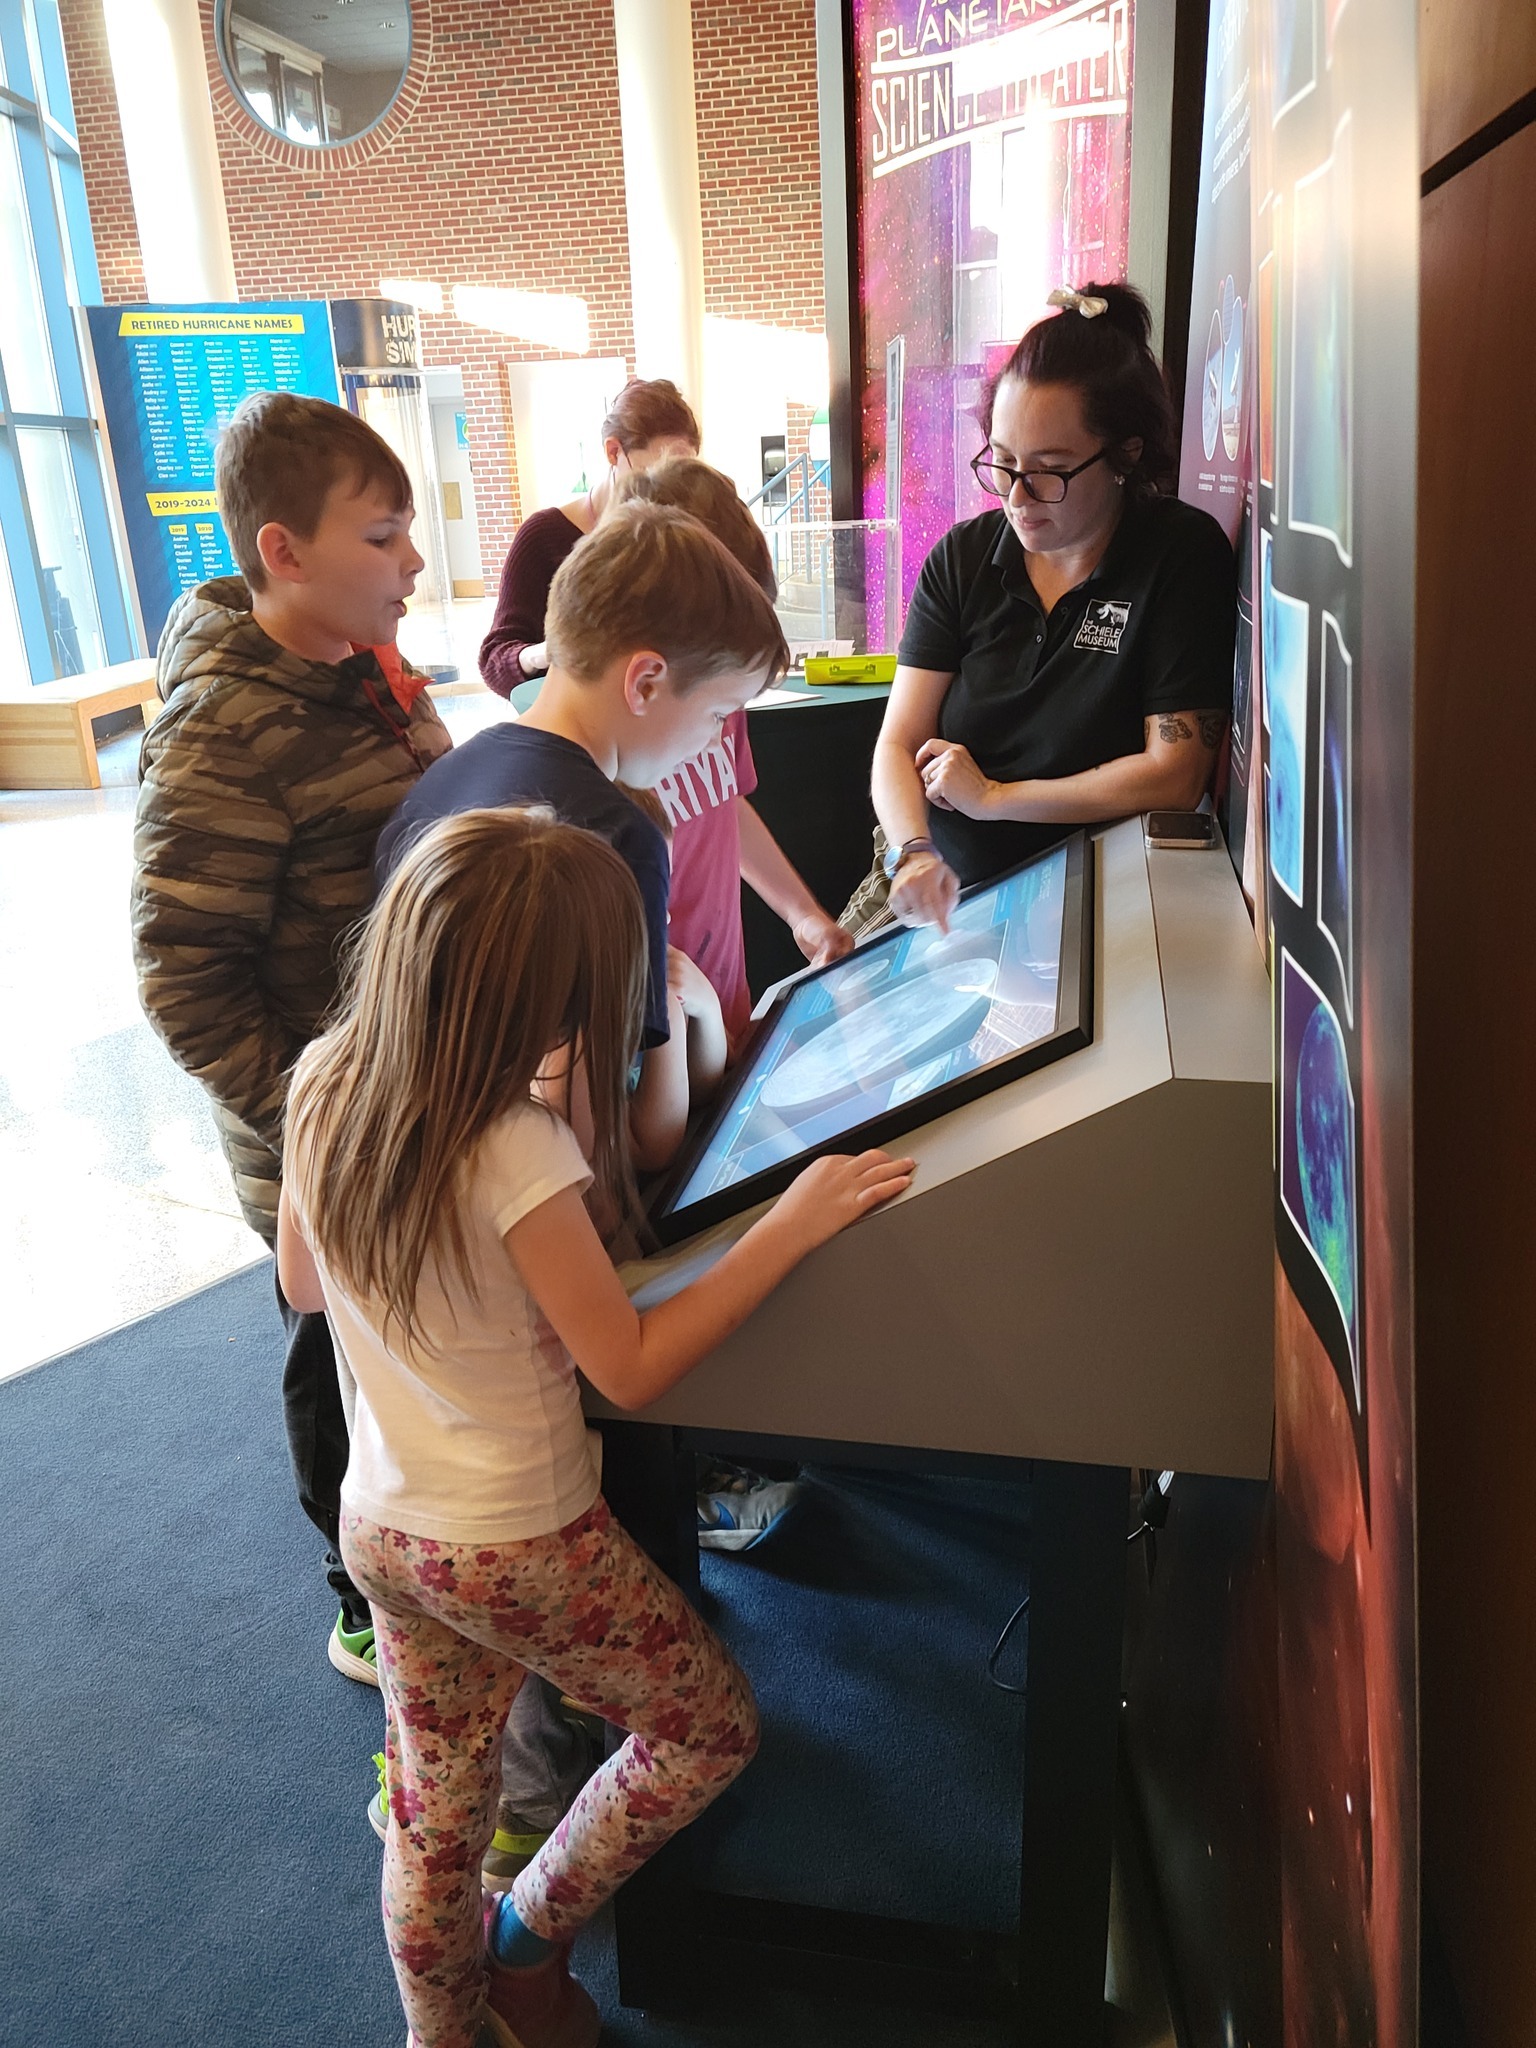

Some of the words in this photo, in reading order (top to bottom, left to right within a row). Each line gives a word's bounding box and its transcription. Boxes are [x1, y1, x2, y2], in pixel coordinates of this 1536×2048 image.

[131, 320, 180, 330] RETIRED
[183, 319, 251, 330] HURRICANE
[254, 318, 293, 329] NAMES
[155, 499, 211, 509] 2019-2024
[1082, 624, 1121, 638] SCHIELE
[1078, 634, 1117, 648] MUSEUM
